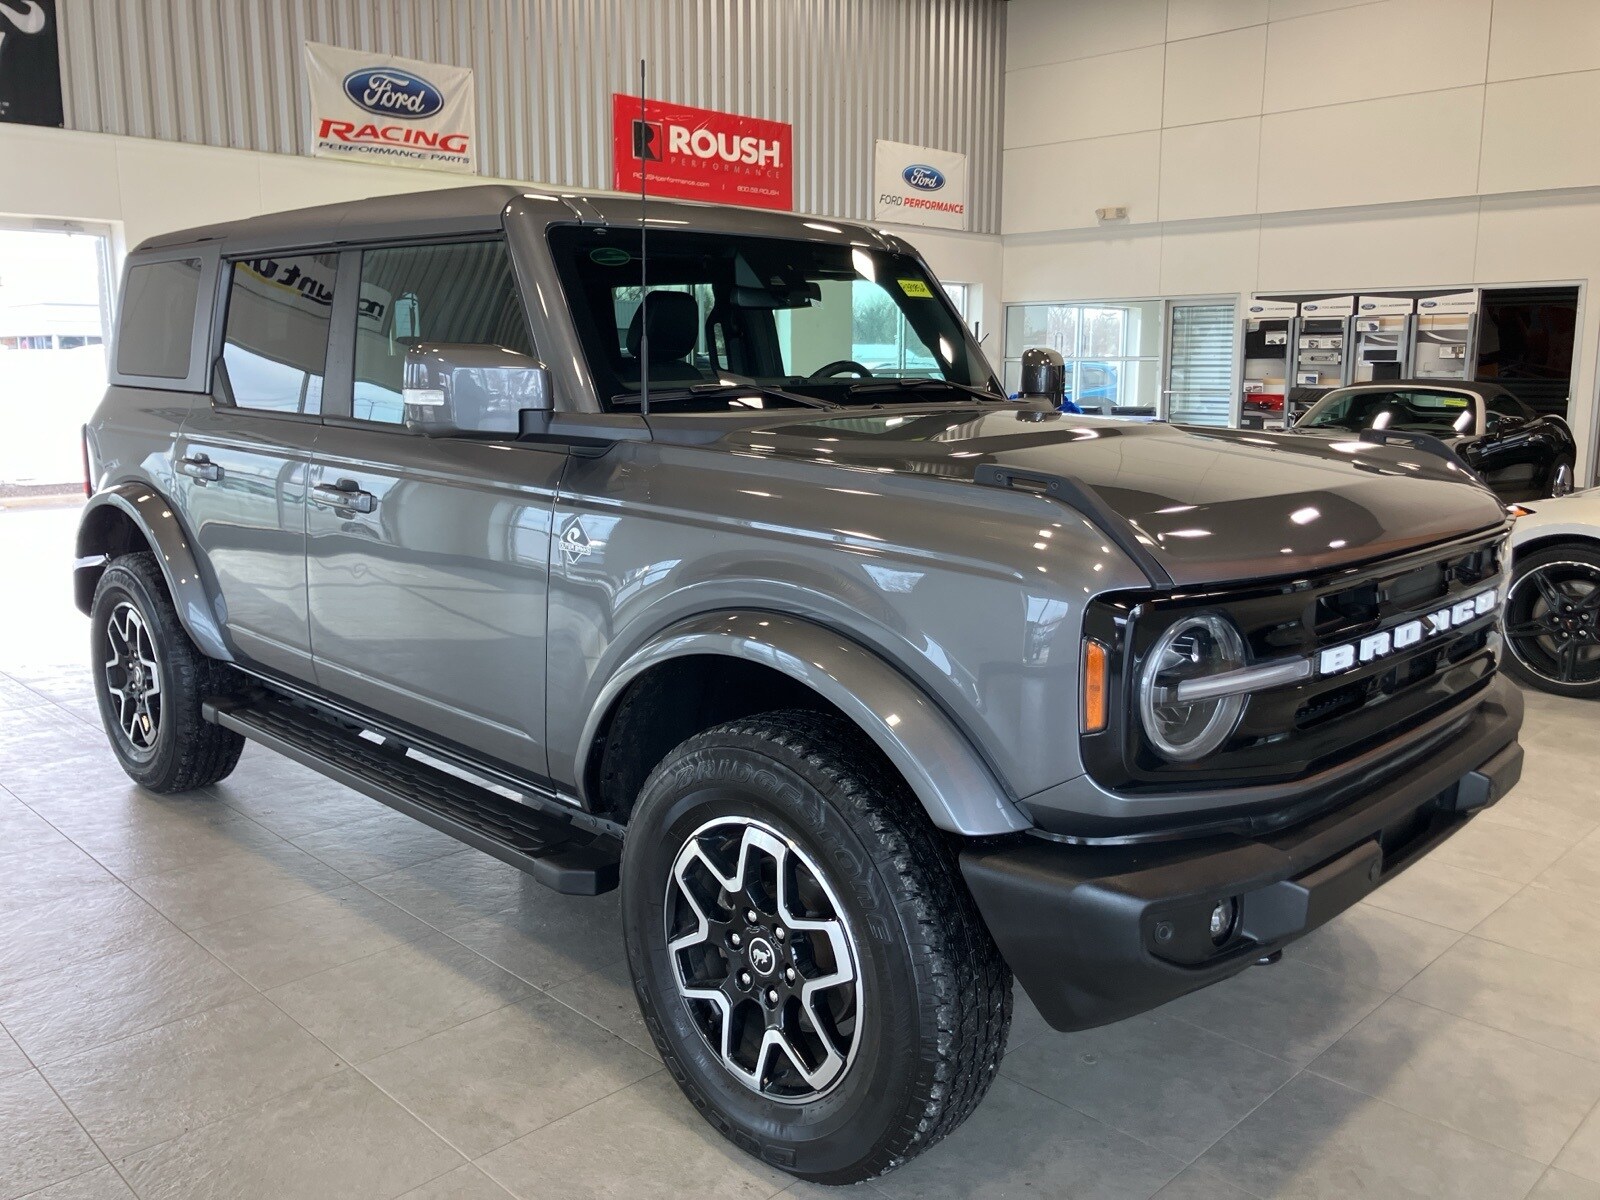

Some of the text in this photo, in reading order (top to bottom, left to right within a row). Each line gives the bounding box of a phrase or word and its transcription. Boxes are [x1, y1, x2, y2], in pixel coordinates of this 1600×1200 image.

[363, 73, 426, 113] Ford
[318, 118, 470, 154] RACING
[668, 124, 781, 168] ROUSH
[318, 141, 470, 165] PERFORMANCE PARTS
[670, 157, 780, 179] PERFORMANCE
[910, 167, 937, 188] Ford
[879, 194, 964, 214] FORD PERFORMANCE
[1320, 590, 1496, 674] BRONCO
